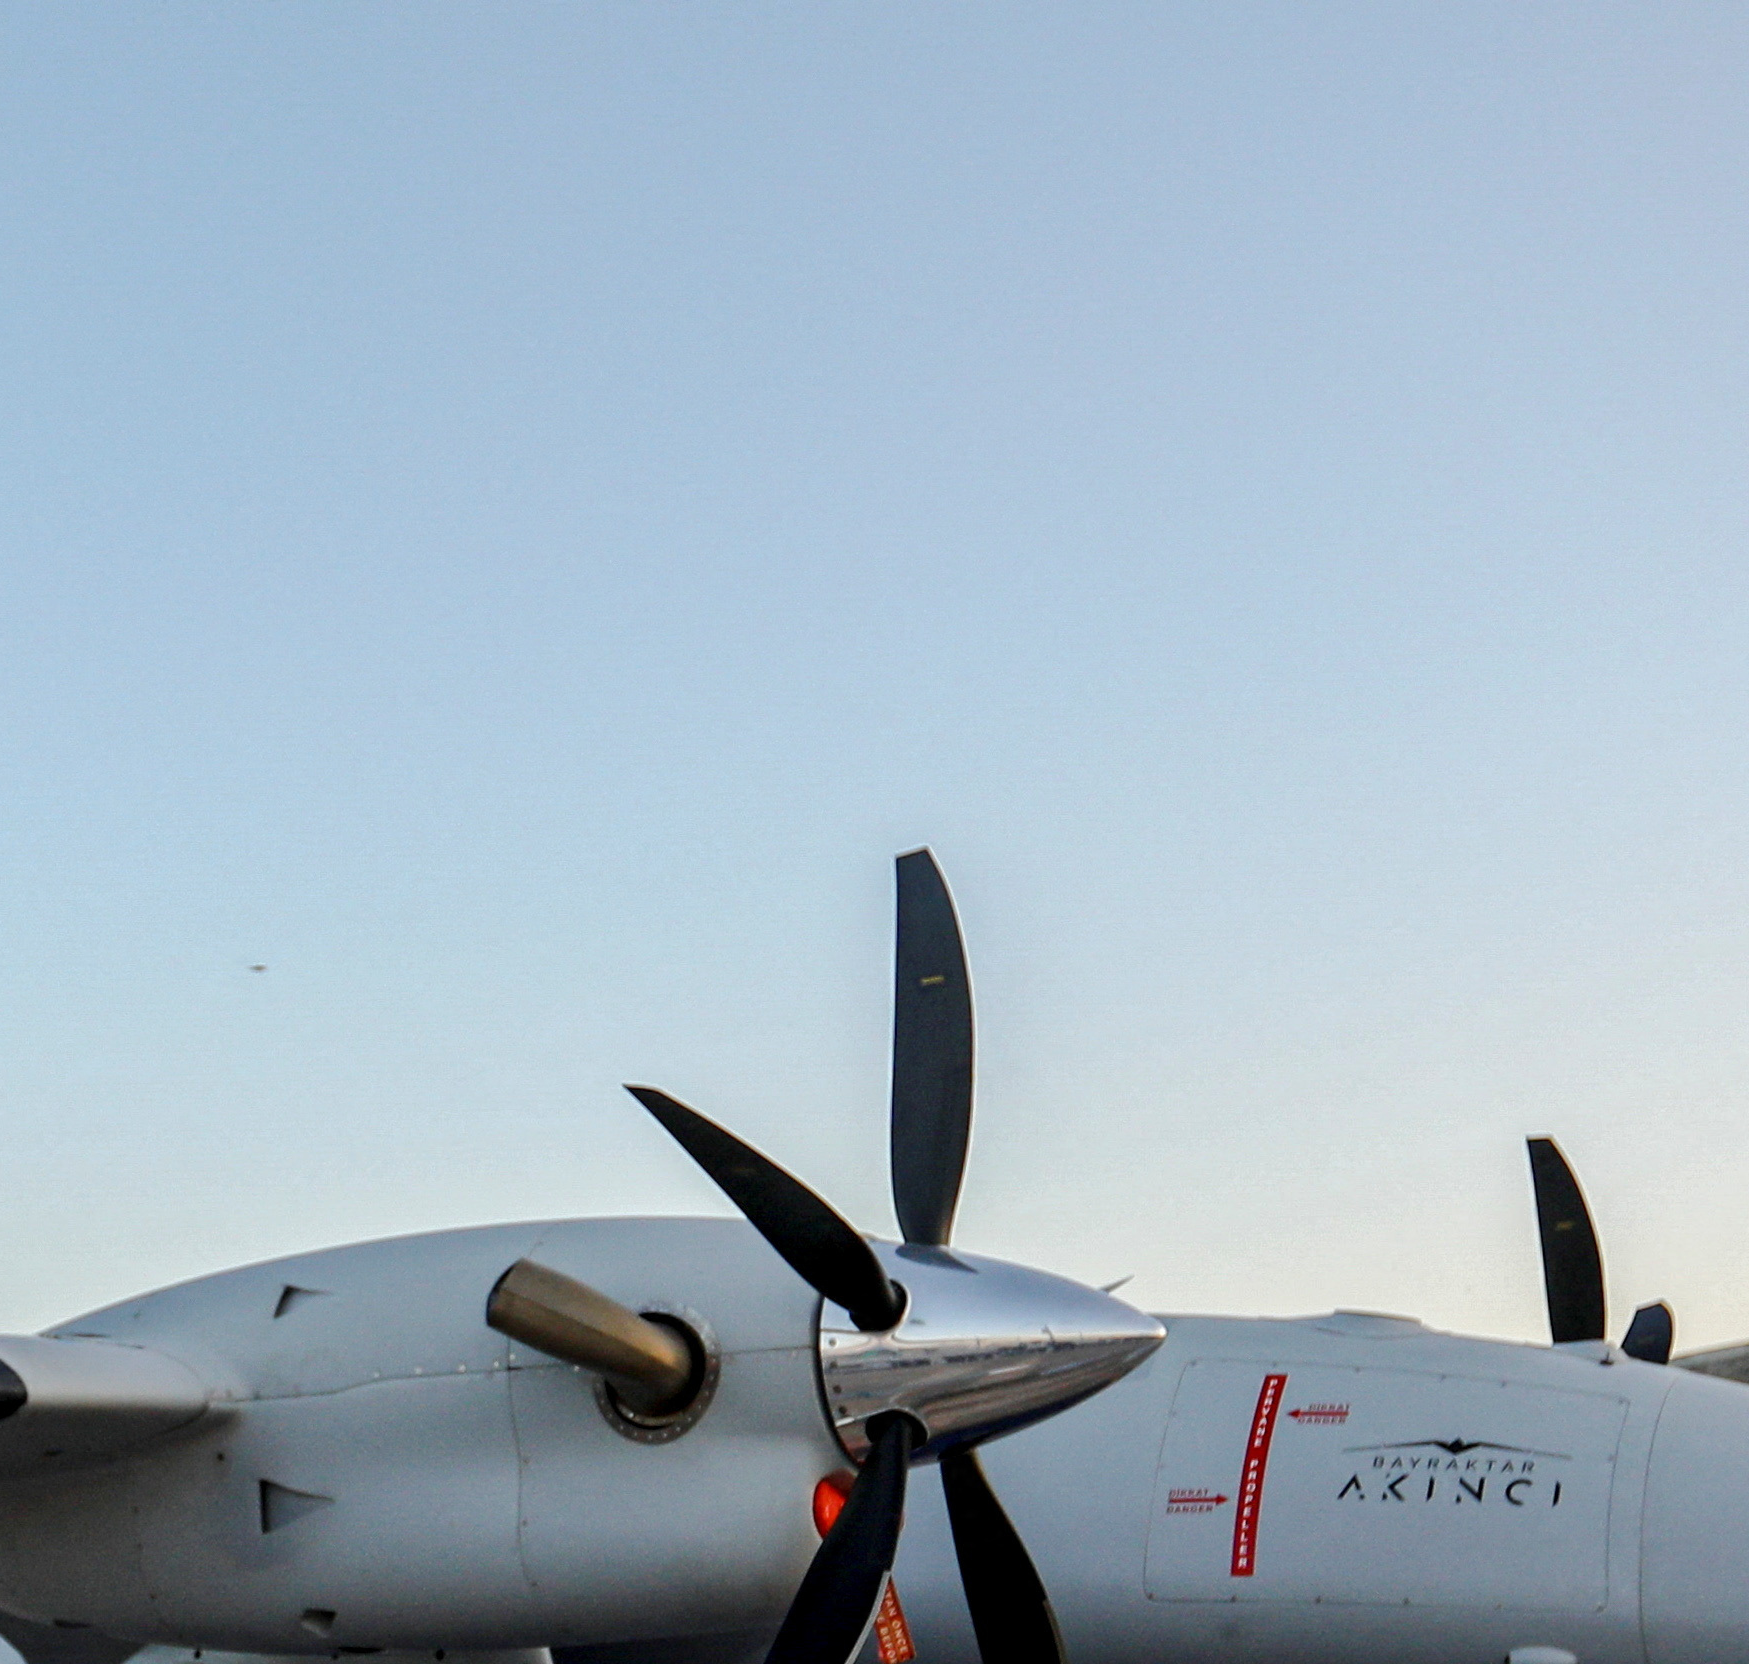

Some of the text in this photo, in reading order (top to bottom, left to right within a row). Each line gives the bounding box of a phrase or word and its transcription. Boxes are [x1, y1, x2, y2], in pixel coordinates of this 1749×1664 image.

[1237, 1378, 1278, 1570] PERVANE PROPELLER
[1372, 1456, 1535, 1474] BAYRAKTAR
[1337, 1472, 1562, 1508] AKINCI
